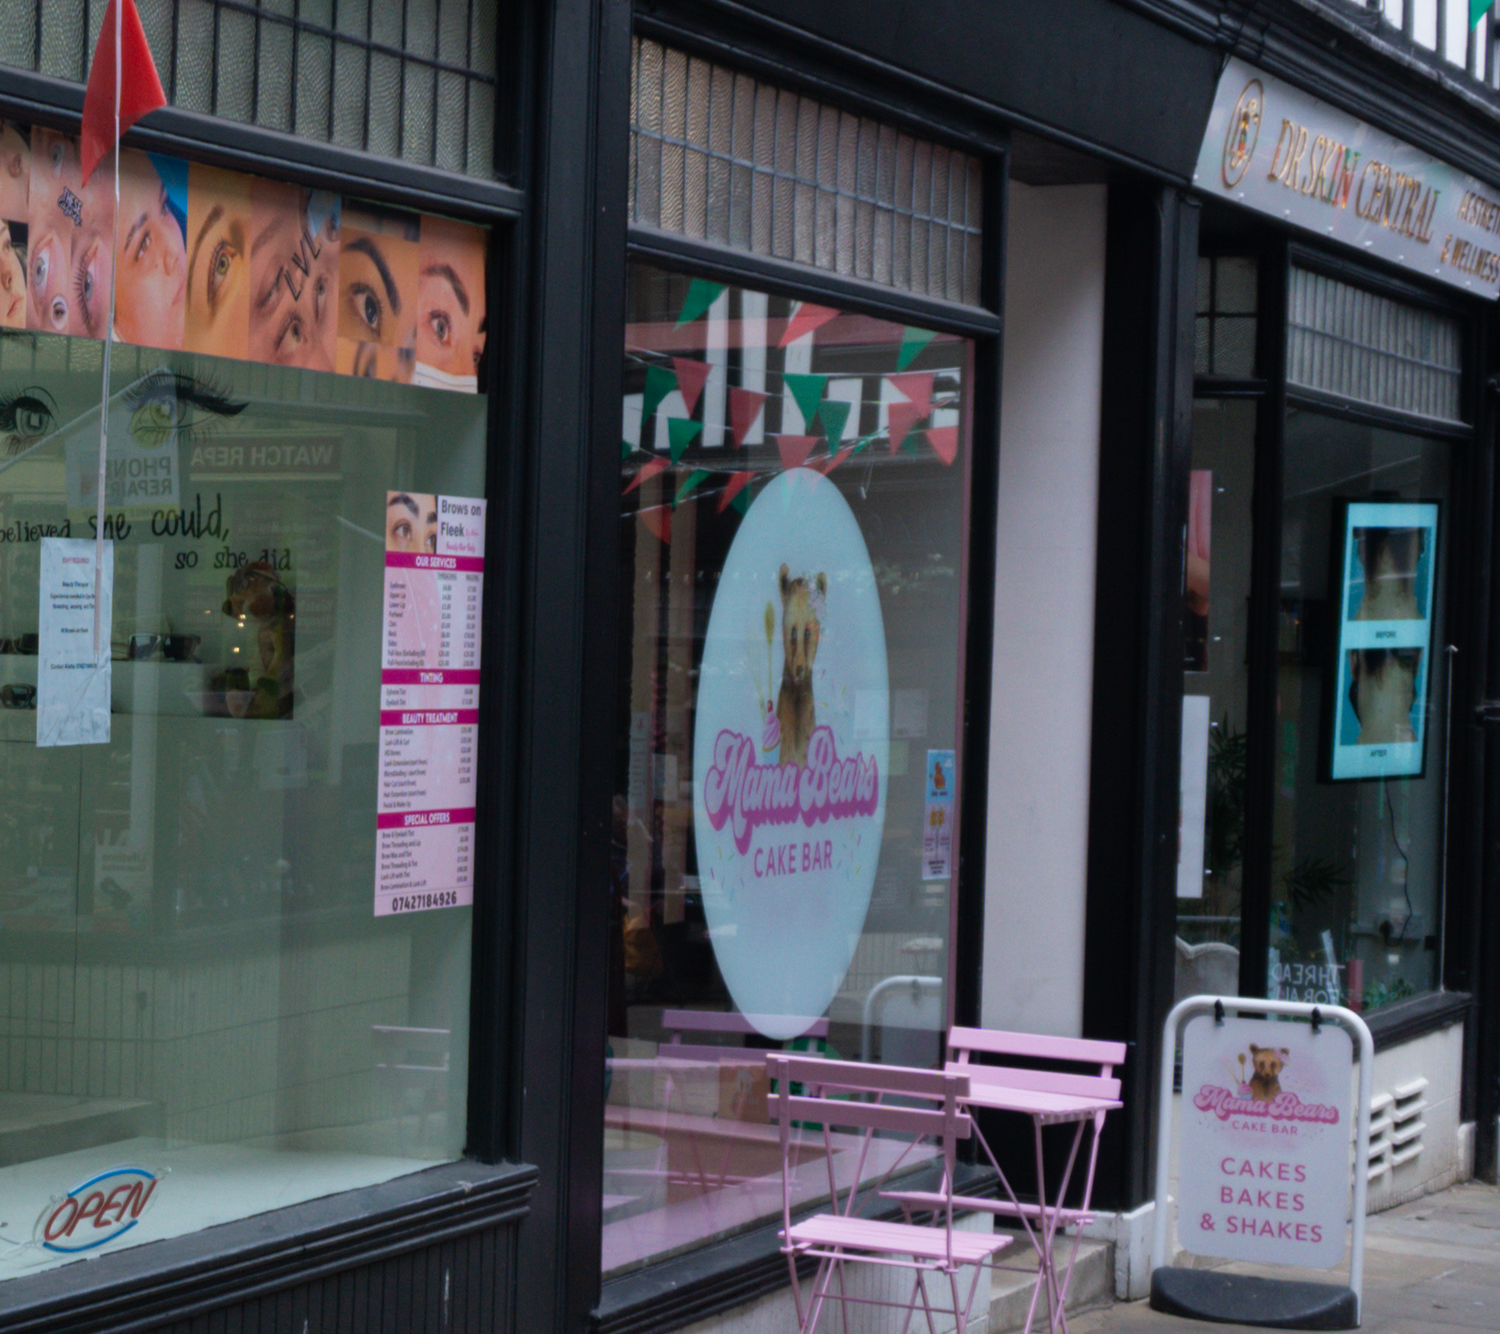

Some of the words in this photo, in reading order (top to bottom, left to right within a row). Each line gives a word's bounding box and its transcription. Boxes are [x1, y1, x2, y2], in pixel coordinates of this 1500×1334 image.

[1267, 119, 1309, 191] DR
[1302, 135, 1362, 208] SKIN
[1355, 160, 1442, 244] CENTRAL
[151, 493, 230, 542] could,
[442, 500, 468, 515] Brows
[471, 505, 481, 516] on
[441, 522, 464, 537] Fleek
[175, 550, 199, 570] so
[213, 546, 249, 569] she
[260, 548, 291, 571] did
[415, 557, 429, 567] OUR
[430, 558, 456, 569] SERVICES
[420, 673, 444, 683] TINTING
[402, 713, 424, 724] BEAUTY
[426, 712, 458, 723] TREATMENT
[704, 728, 800, 856] Mama
[798, 725, 880, 829] Bears
[404, 815, 427, 825] SPECIAL
[429, 813, 450, 823] OFFERS
[754, 843, 798, 878] CAKE
[801, 840, 834, 871] BAR
[392, 891, 457, 912] 07427184926
[1193, 1083, 1268, 1124] Mama
[1267, 1090, 1340, 1125] Bears
[1232, 1119, 1268, 1135] CAKE
[1270, 1121, 1299, 1137] BAR
[1220, 1156, 1308, 1183] CAKES
[44, 1179, 158, 1241] OPEN
[1219, 1186, 1306, 1213] BAKES
[1199, 1213, 1216, 1233] &
[1226, 1215, 1323, 1243] SHAKES
